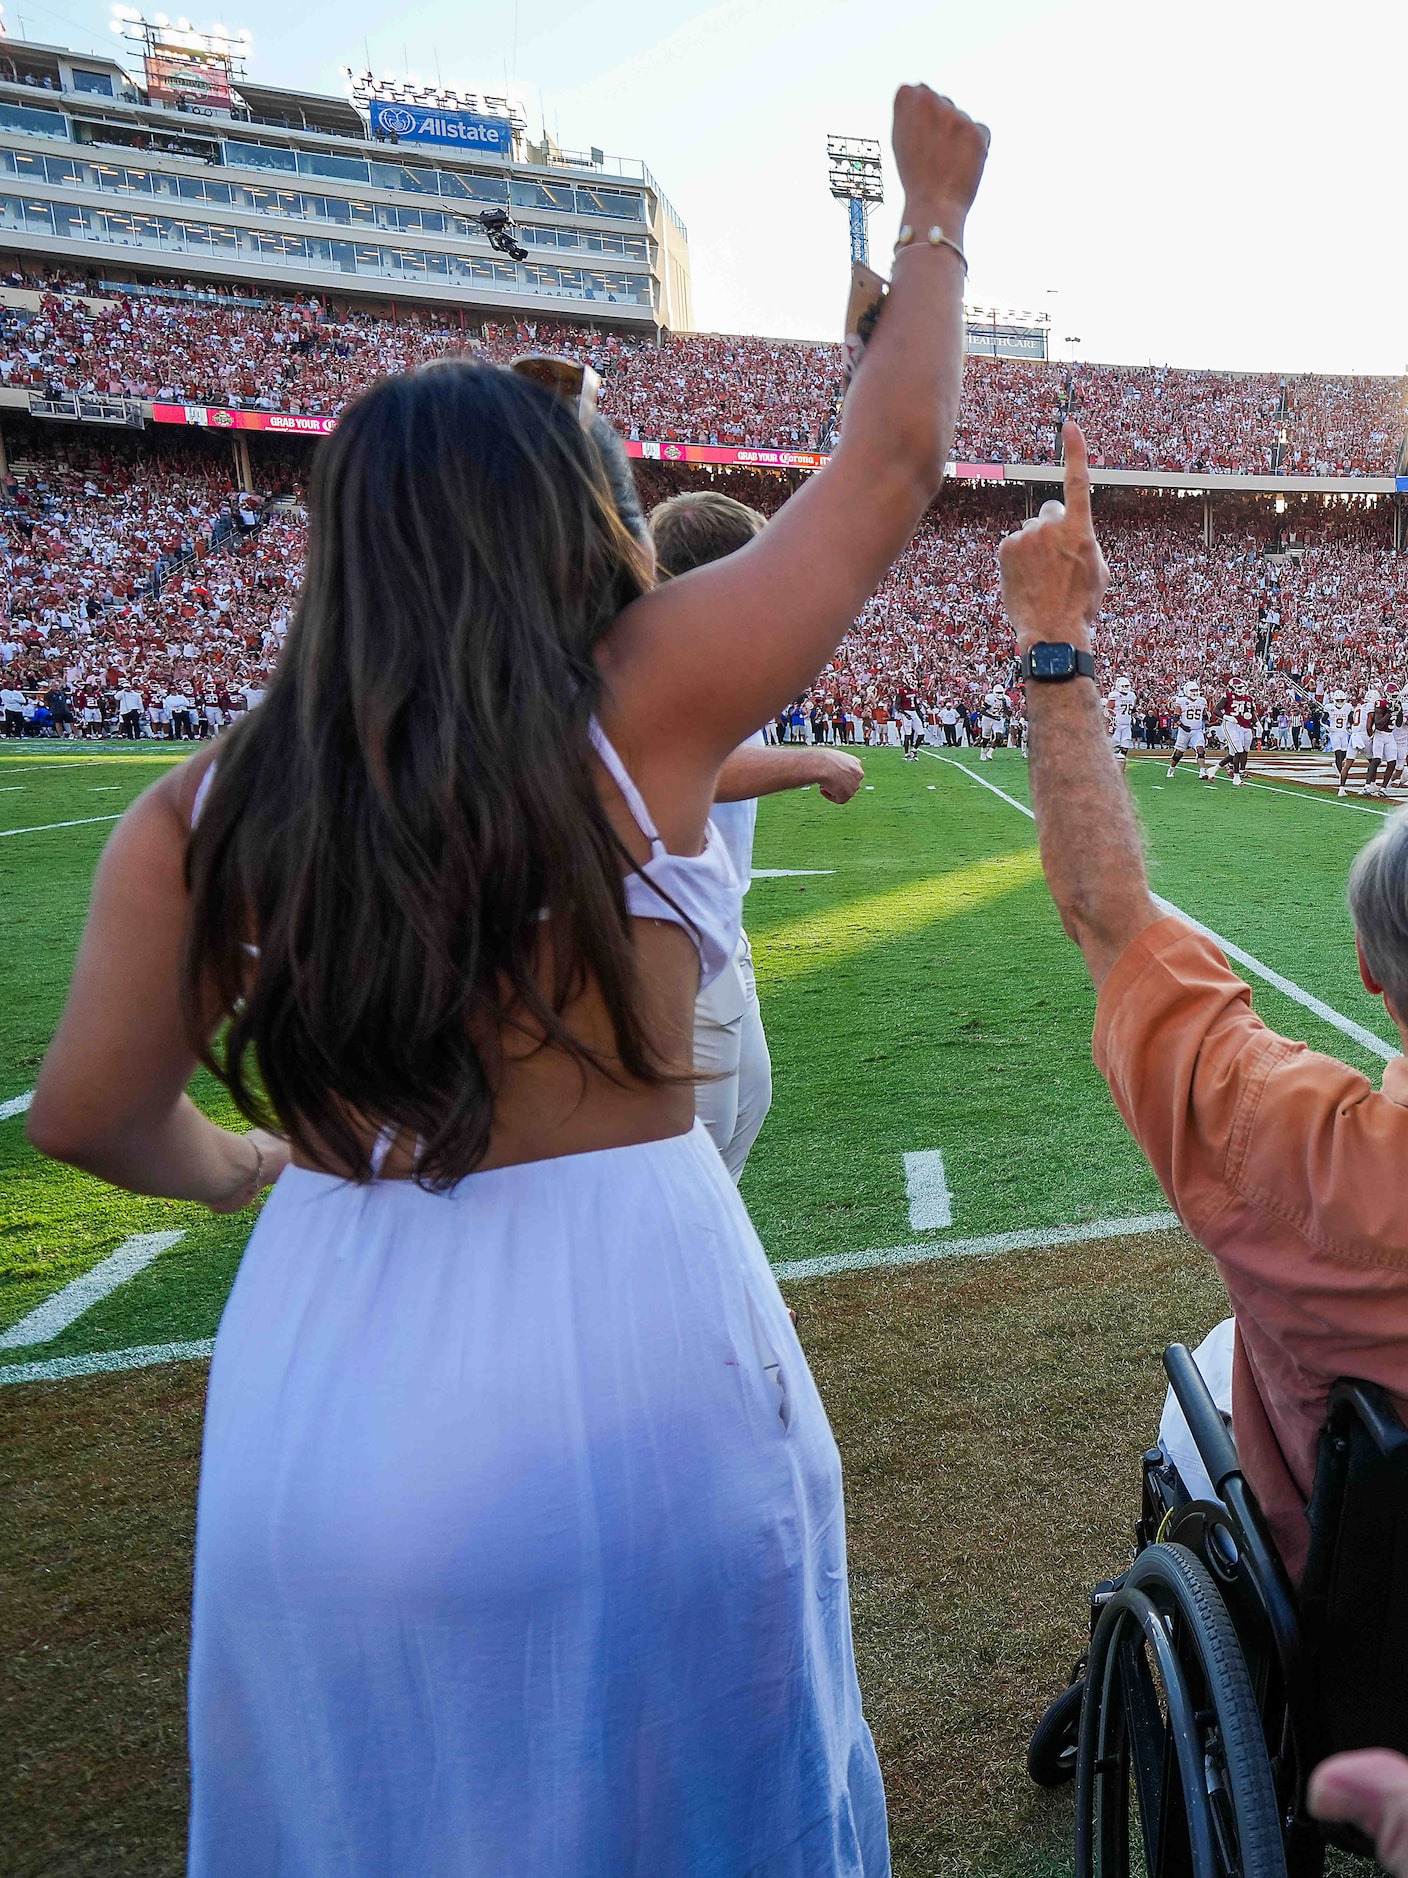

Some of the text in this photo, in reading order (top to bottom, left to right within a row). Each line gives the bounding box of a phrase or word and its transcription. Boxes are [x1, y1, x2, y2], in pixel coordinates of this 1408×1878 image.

[418, 117, 499, 142] Allstate
[270, 416, 295, 428] GRAB
[296, 419, 319, 430] YOUR
[738, 451, 758, 461] GRAB
[758, 452, 778, 463] YOUR
[1186, 708, 1201, 720] 65
[1335, 718, 1344, 729] 9
